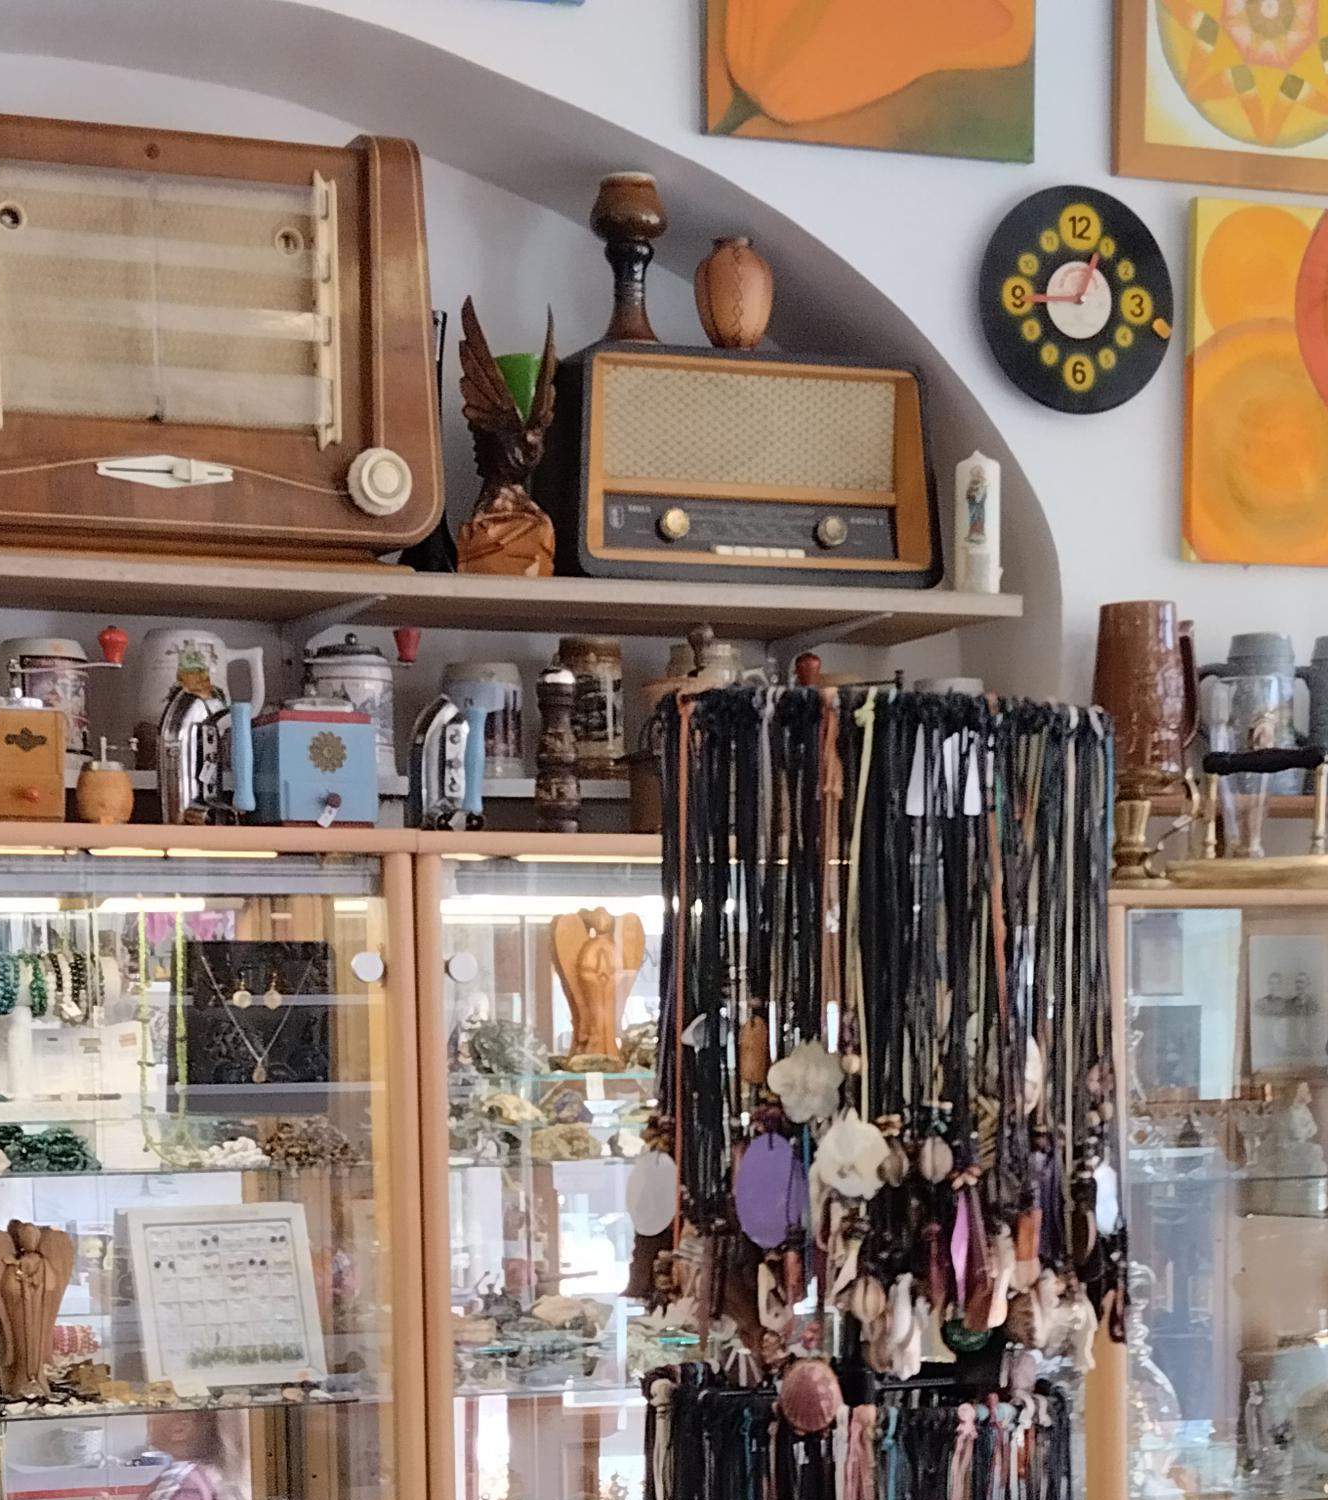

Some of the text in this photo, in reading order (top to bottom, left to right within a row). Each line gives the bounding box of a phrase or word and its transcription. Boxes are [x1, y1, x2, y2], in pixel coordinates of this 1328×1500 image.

[1068, 216, 1091, 241] 12
[1121, 264, 1129, 277] 2
[1011, 285, 1026, 309] 9
[1129, 294, 1145, 318] 3
[1072, 361, 1087, 385] 6
